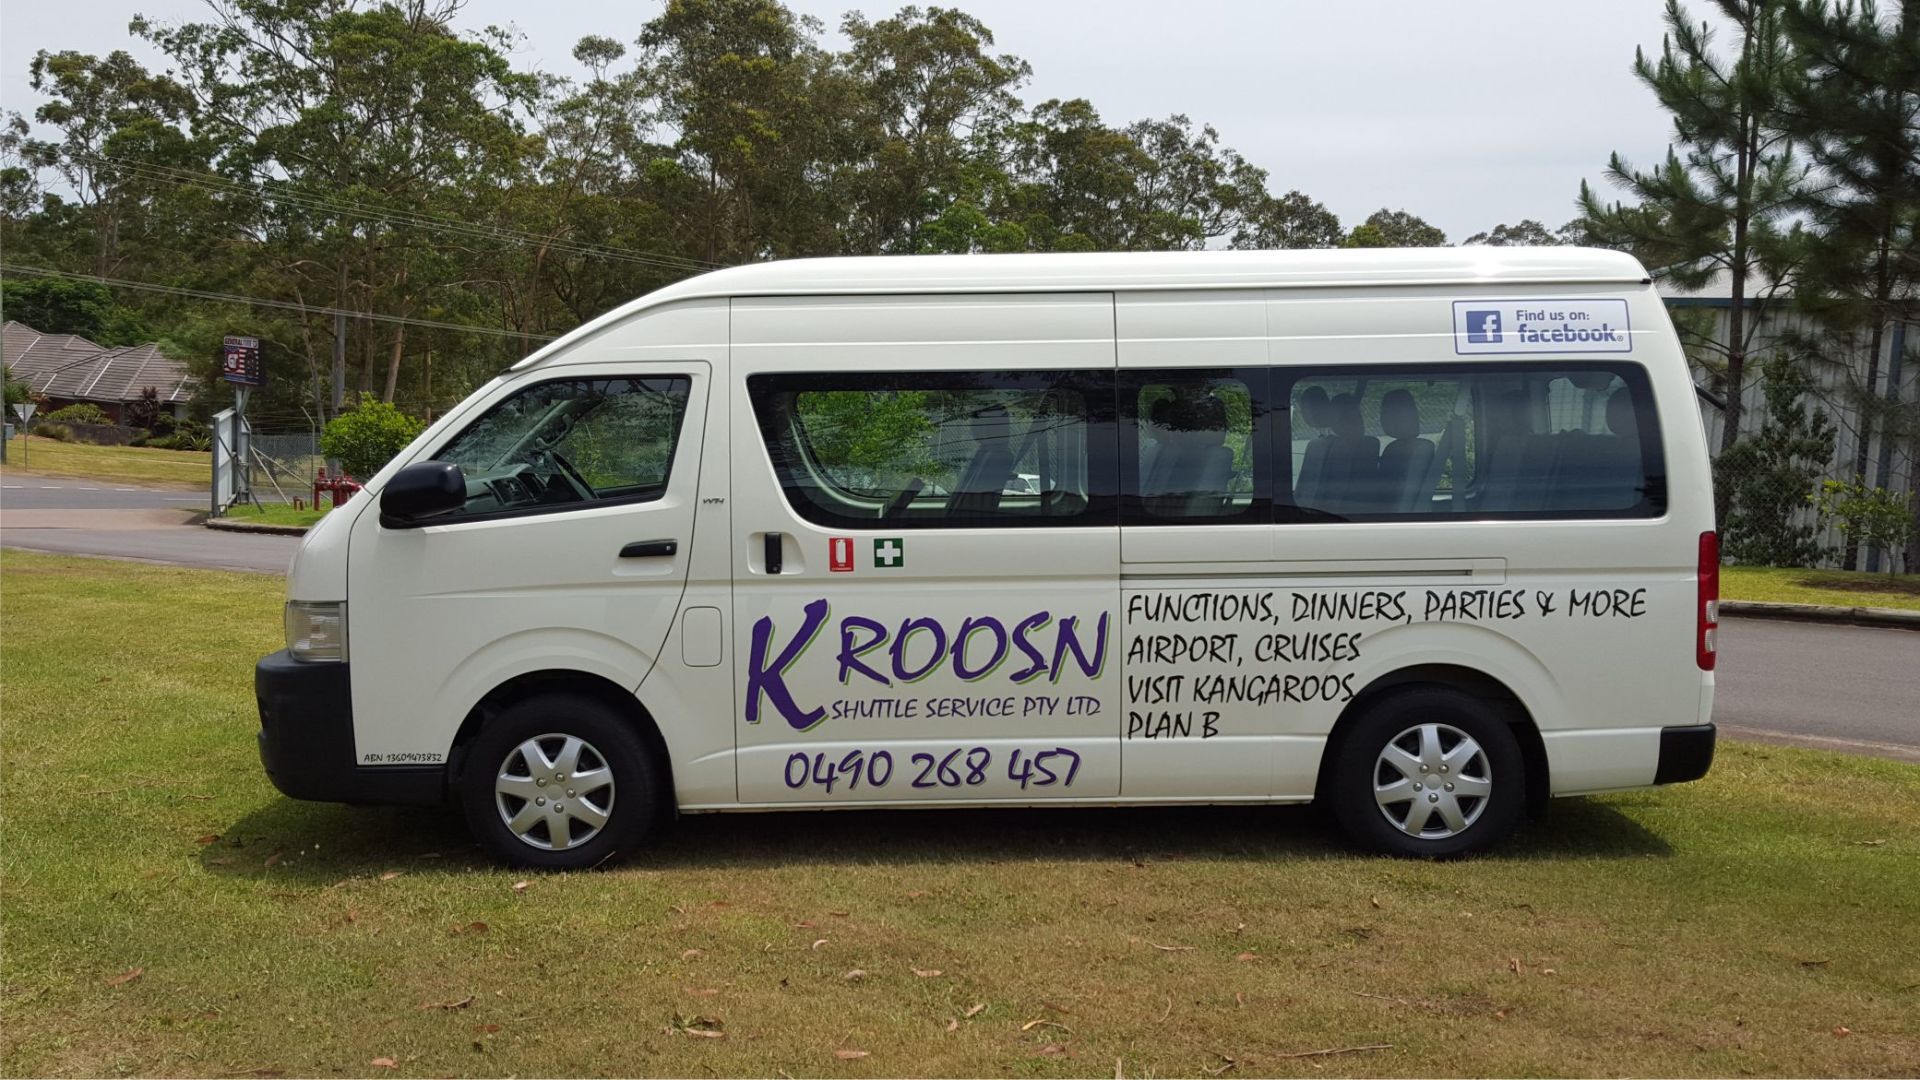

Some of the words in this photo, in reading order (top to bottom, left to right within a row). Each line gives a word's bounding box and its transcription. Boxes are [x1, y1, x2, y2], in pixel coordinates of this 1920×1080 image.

[1516, 310, 1546, 322] Find
[1549, 311, 1566, 321] us
[1568, 311, 1591, 321] on:
[1127, 592, 1279, 626] FUNCTIONS,
[1292, 591, 1413, 625] DINNERS,
[1425, 590, 1526, 622] PARTIES
[1535, 591, 1557, 617] &
[1569, 588, 1647, 619] MORE
[745, 599, 1111, 732] KROOSN
[1127, 634, 1243, 667] AIRPORT,
[1255, 632, 1362, 663] CRUISES
[1128, 675, 1185, 704] VISIT
[1193, 673, 1354, 707] KANGAROOS
[831, 698, 918, 720] SHUTTLE
[925, 697, 1016, 719] SERVICE
[1023, 696, 1060, 718] PTY
[1066, 696, 1101, 717] LTD
[1128, 711, 1193, 740] PLAN
[1201, 711, 1221, 739] B
[784, 750, 895, 795] 0490
[911, 747, 992, 790] 268
[1007, 747, 1081, 791] 457
